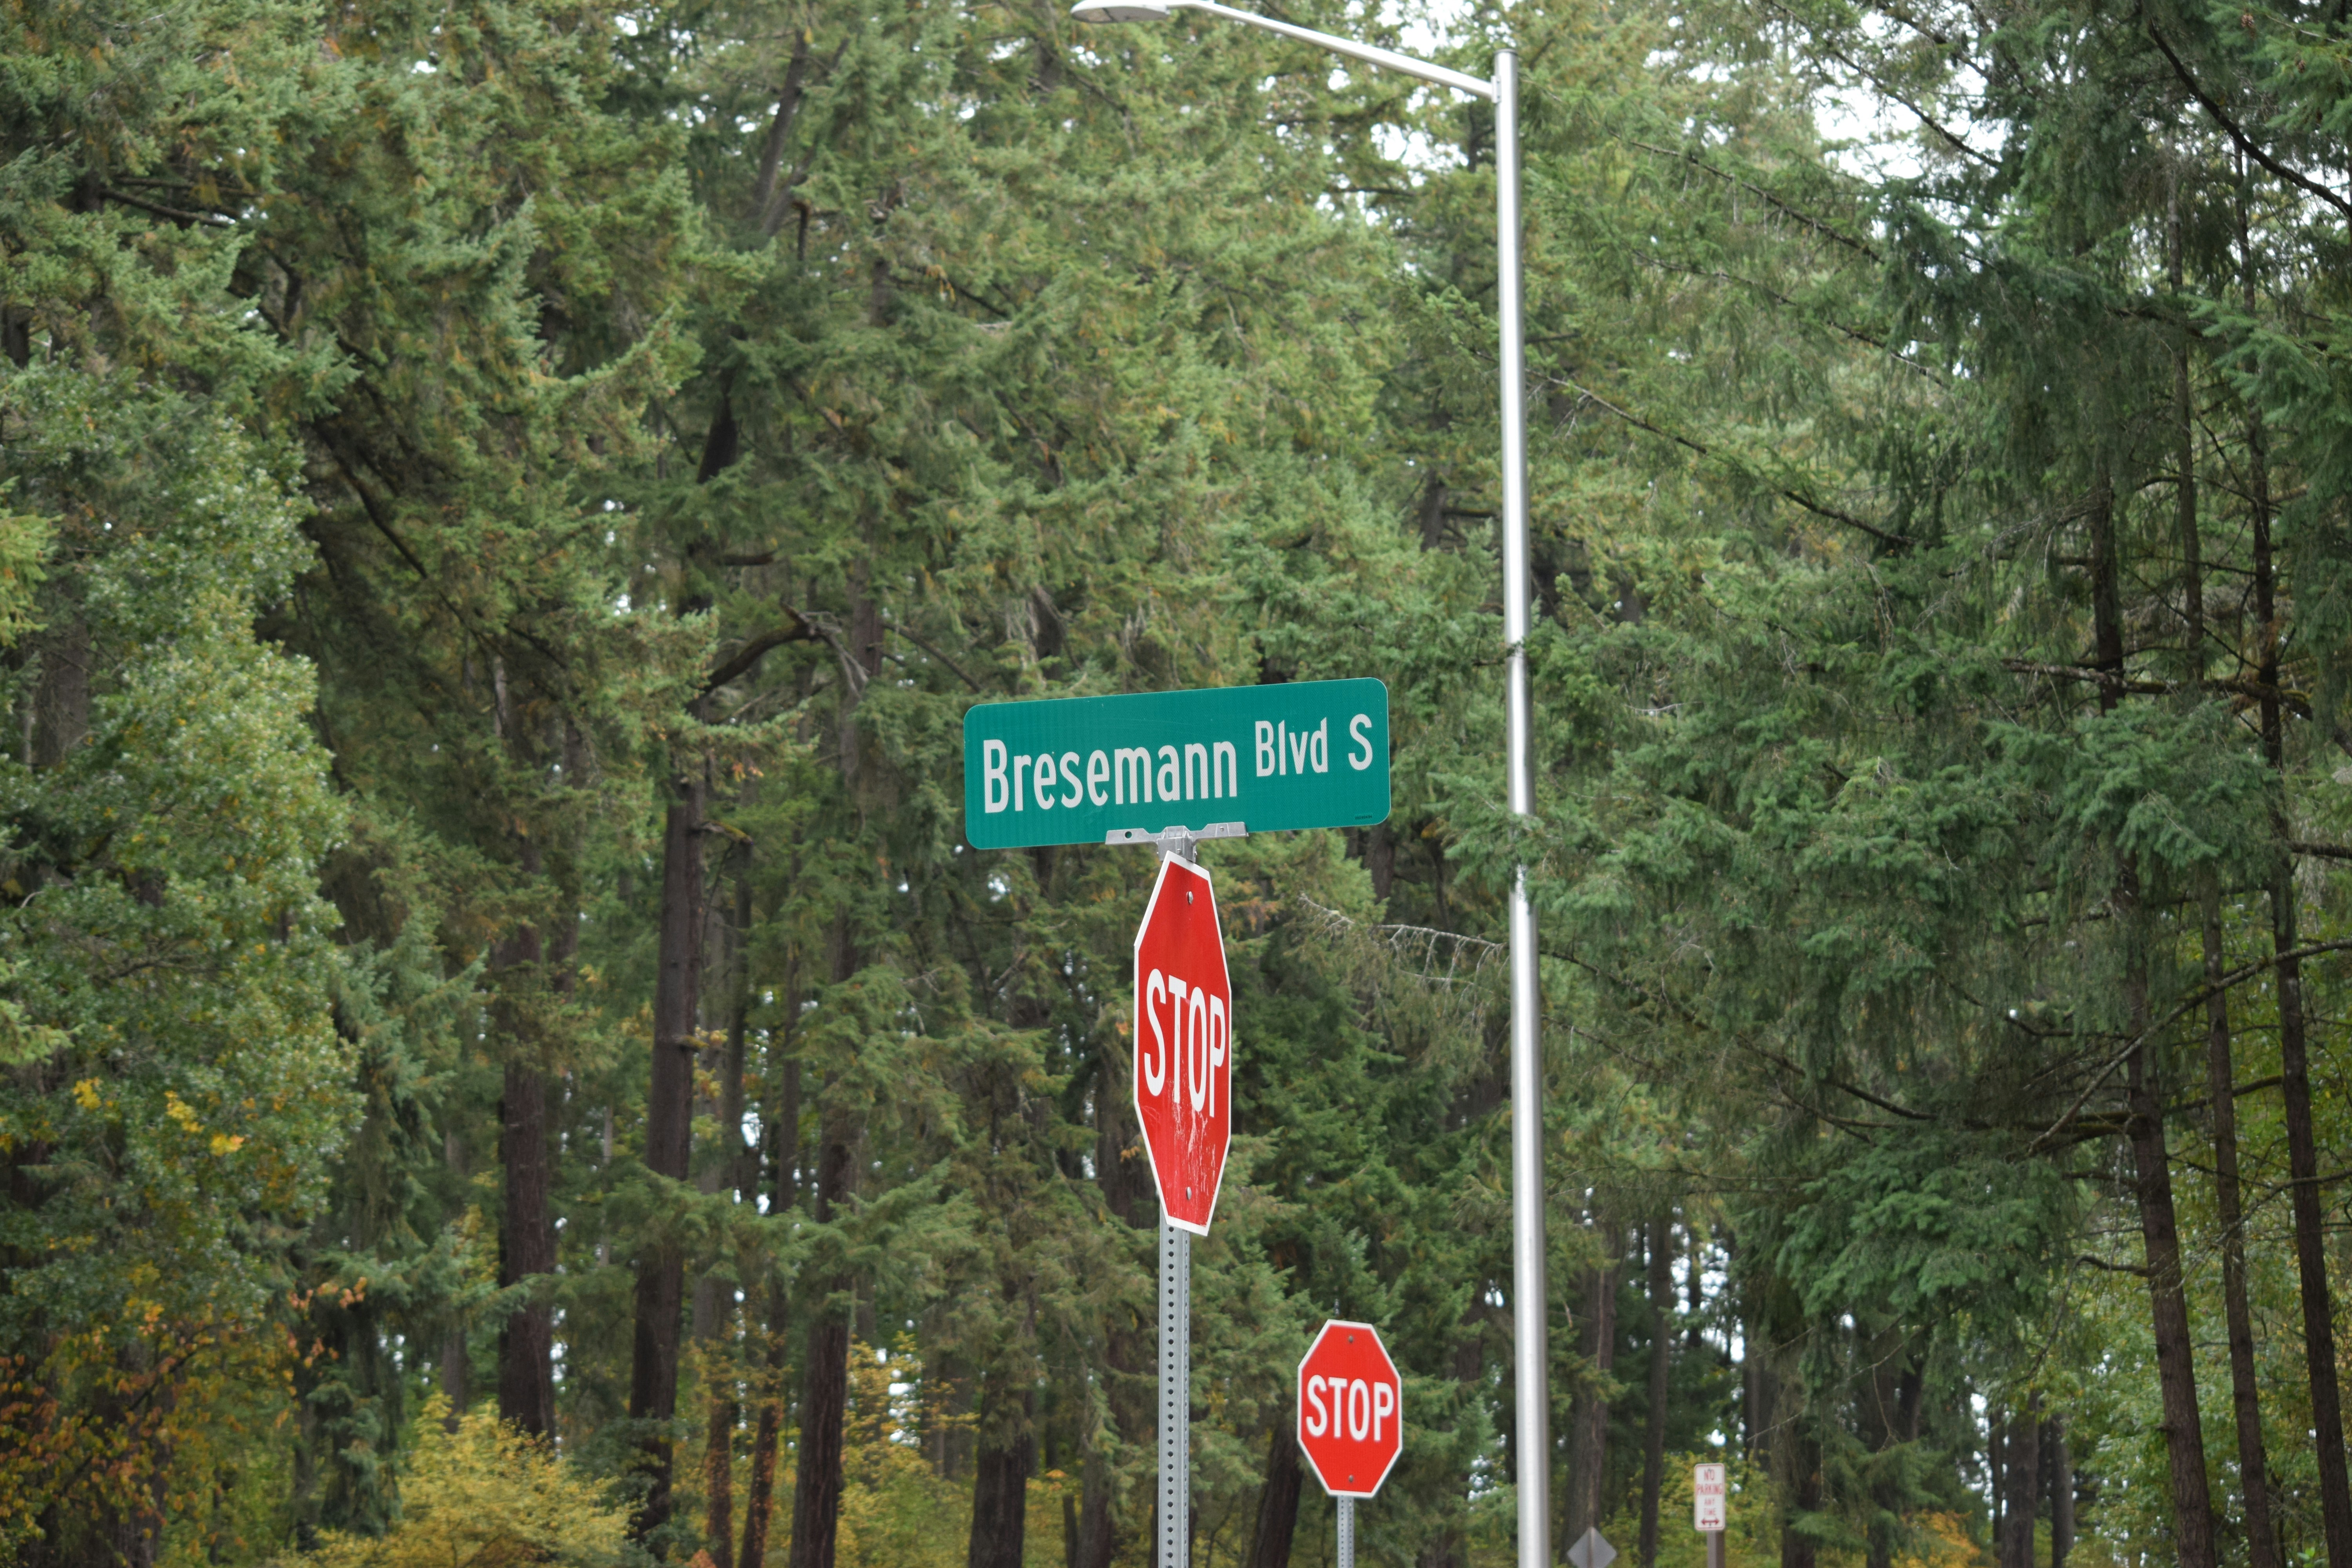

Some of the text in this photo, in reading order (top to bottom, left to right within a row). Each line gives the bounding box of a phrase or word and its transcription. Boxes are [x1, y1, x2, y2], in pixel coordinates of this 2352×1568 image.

[983, 713, 1373, 813] Bresemann Blvd S
[1144, 968, 1226, 1118] STOP
[1306, 1374, 1394, 1441] STOP
[1696, 1484, 1722, 1495] PARKING
[1704, 1469, 1715, 1481] NO
